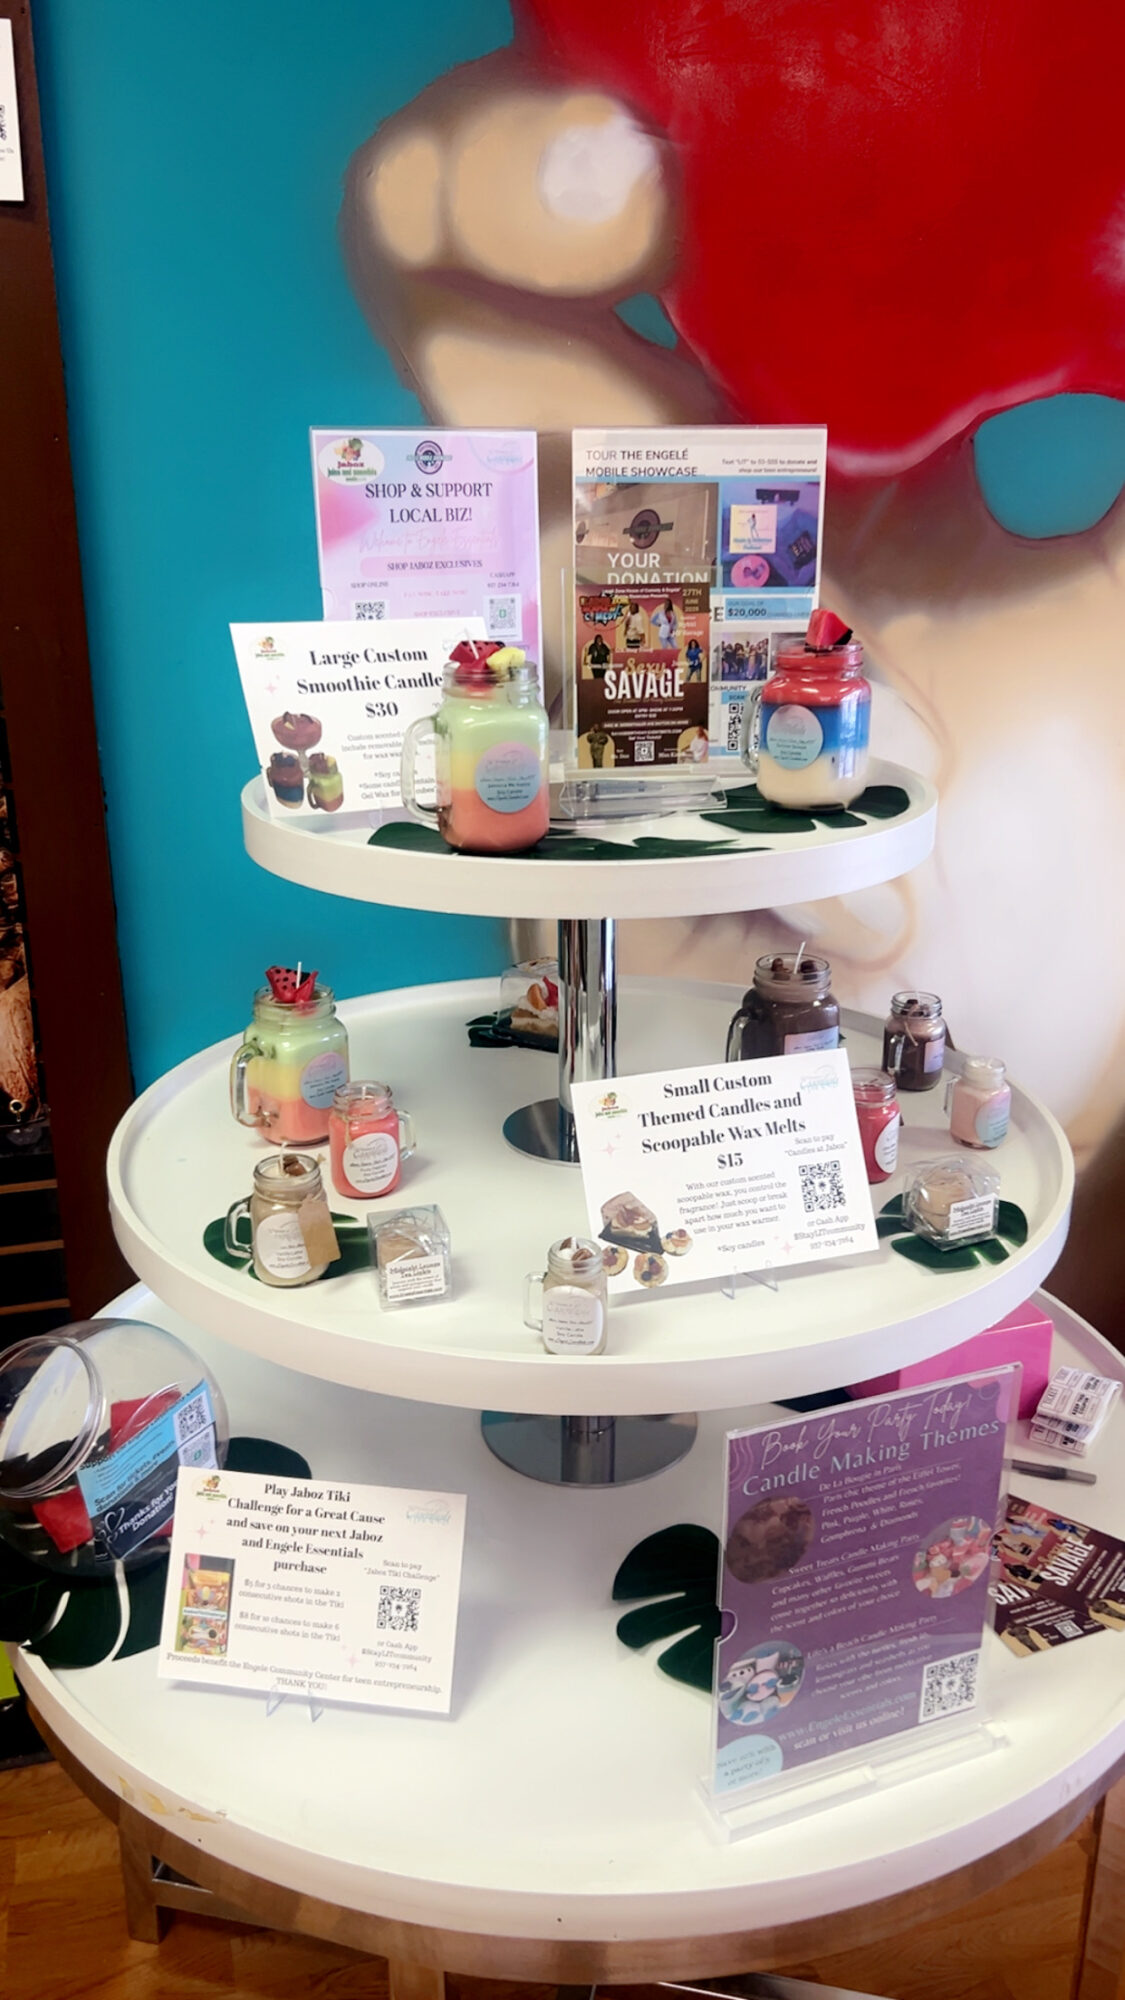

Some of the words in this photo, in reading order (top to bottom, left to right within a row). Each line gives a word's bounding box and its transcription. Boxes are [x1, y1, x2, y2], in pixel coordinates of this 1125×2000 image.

[586, 450, 617, 460] TOUR
[620, 450, 642, 460] THE
[645, 448, 688, 460] ENGELÉ
[586, 467, 628, 477] MOBILE
[631, 467, 697, 476] SHOWCASE
[365, 483, 406, 498] SHOP
[411, 483, 422, 498] &
[426, 483, 492, 498] SUPPORT
[390, 508, 442, 523] LOCAL
[445, 507, 473, 522] BIZ!
[387, 562, 408, 571] SHOP
[435, 560, 483, 569] EXCLUSIVES
[607, 553, 661, 567] YOUR
[607, 572, 709, 584] DONATION
[728, 608, 767, 617] $20,000
[309, 650, 360, 669] Large
[363, 649, 428, 664] Custom
[626, 658, 666, 678] Sexy
[297, 673, 381, 694] Smoothie
[604, 669, 684, 700] SAVAGE
[365, 701, 399, 719] $30
[342, 743, 366, 751] include
[368, 741, 402, 750] removable
[347, 733, 372, 741] Custom
[374, 732, 400, 740] scented
[663, 1078, 710, 1099] Small
[713, 1074, 772, 1092] Custom
[638, 1105, 705, 1128] Themed
[709, 1098, 771, 1118] Candles
[774, 1092, 802, 1110] and
[642, 1129, 725, 1154] Scoopable
[728, 1125, 762, 1141] Wax
[765, 1118, 806, 1136] Melts
[821, 1134, 834, 1142] pay
[717, 1153, 744, 1169] $15
[720, 1177, 747, 1186] custom
[748, 1171, 775, 1181] scented
[677, 1192, 714, 1203] scoopable
[734, 1187, 747, 1197] you
[748, 1183, 774, 1192] control
[679, 1202, 719, 1215] fragrance!
[720, 1200, 737, 1209] Just
[738, 1197, 758, 1206] scoop
[767, 1192, 788, 1200] break
[815, 1217, 833, 1225] Cash
[835, 1215, 849, 1223] App
[737, 1239, 765, 1250] candles
[760, 1425, 808, 1471] Book
[813, 1419, 862, 1460] Your
[867, 1402, 923, 1443] Party
[923, 1384, 972, 1431] Today!
[743, 1464, 821, 1496] Candle
[830, 1442, 911, 1474] Making
[919, 1420, 1000, 1451] Themes
[883, 1464, 902, 1474] Paris
[264, 1483, 288, 1499] Play
[290, 1486, 324, 1499] Jaboz
[326, 1489, 351, 1502] Tiki
[119, 1504, 150, 1534] Thanks
[151, 1492, 166, 1508] for
[165, 1480, 177, 1497] You
[132, 1492, 174, 1532] Donation!
[228, 1498, 284, 1516] Challenge
[286, 1504, 304, 1516] for
[315, 1507, 348, 1521] Great
[350, 1510, 385, 1524] Cause
[226, 1517, 248, 1528] and
[250, 1521, 274, 1531] save
[276, 1524, 290, 1533] on
[291, 1525, 319, 1536] your
[321, 1527, 347, 1539] next
[349, 1530, 383, 1543] Jaboz
[242, 1538, 263, 1548] and
[265, 1539, 304, 1553] Engele
[306, 1543, 364, 1559] Essentials
[789, 1563, 814, 1575] Sweet
[841, 1548, 869, 1561] Candle
[870, 1539, 899, 1552] Making
[901, 1534, 920, 1544] Party
[273, 1560, 327, 1574] purchase
[1040, 1536, 1095, 1586] SAVAGE
[272, 1583, 303, 1592] chances
[314, 1588, 335, 1596] make
[166, 1652, 200, 1664] Proceeds
[202, 1656, 228, 1667] benefit
[228, 1660, 241, 1668] the
[243, 1661, 268, 1672] Engele
[270, 1665, 313, 1679] Community
[315, 1671, 340, 1681] Center
[342, 1674, 353, 1682] for
[355, 1677, 372, 1685] teen
[276, 1677, 306, 1688] THANK
[793, 1737, 817, 1750] scan
[819, 1731, 831, 1743] or
[833, 1724, 853, 1738] visit
[855, 1720, 868, 1730] us
